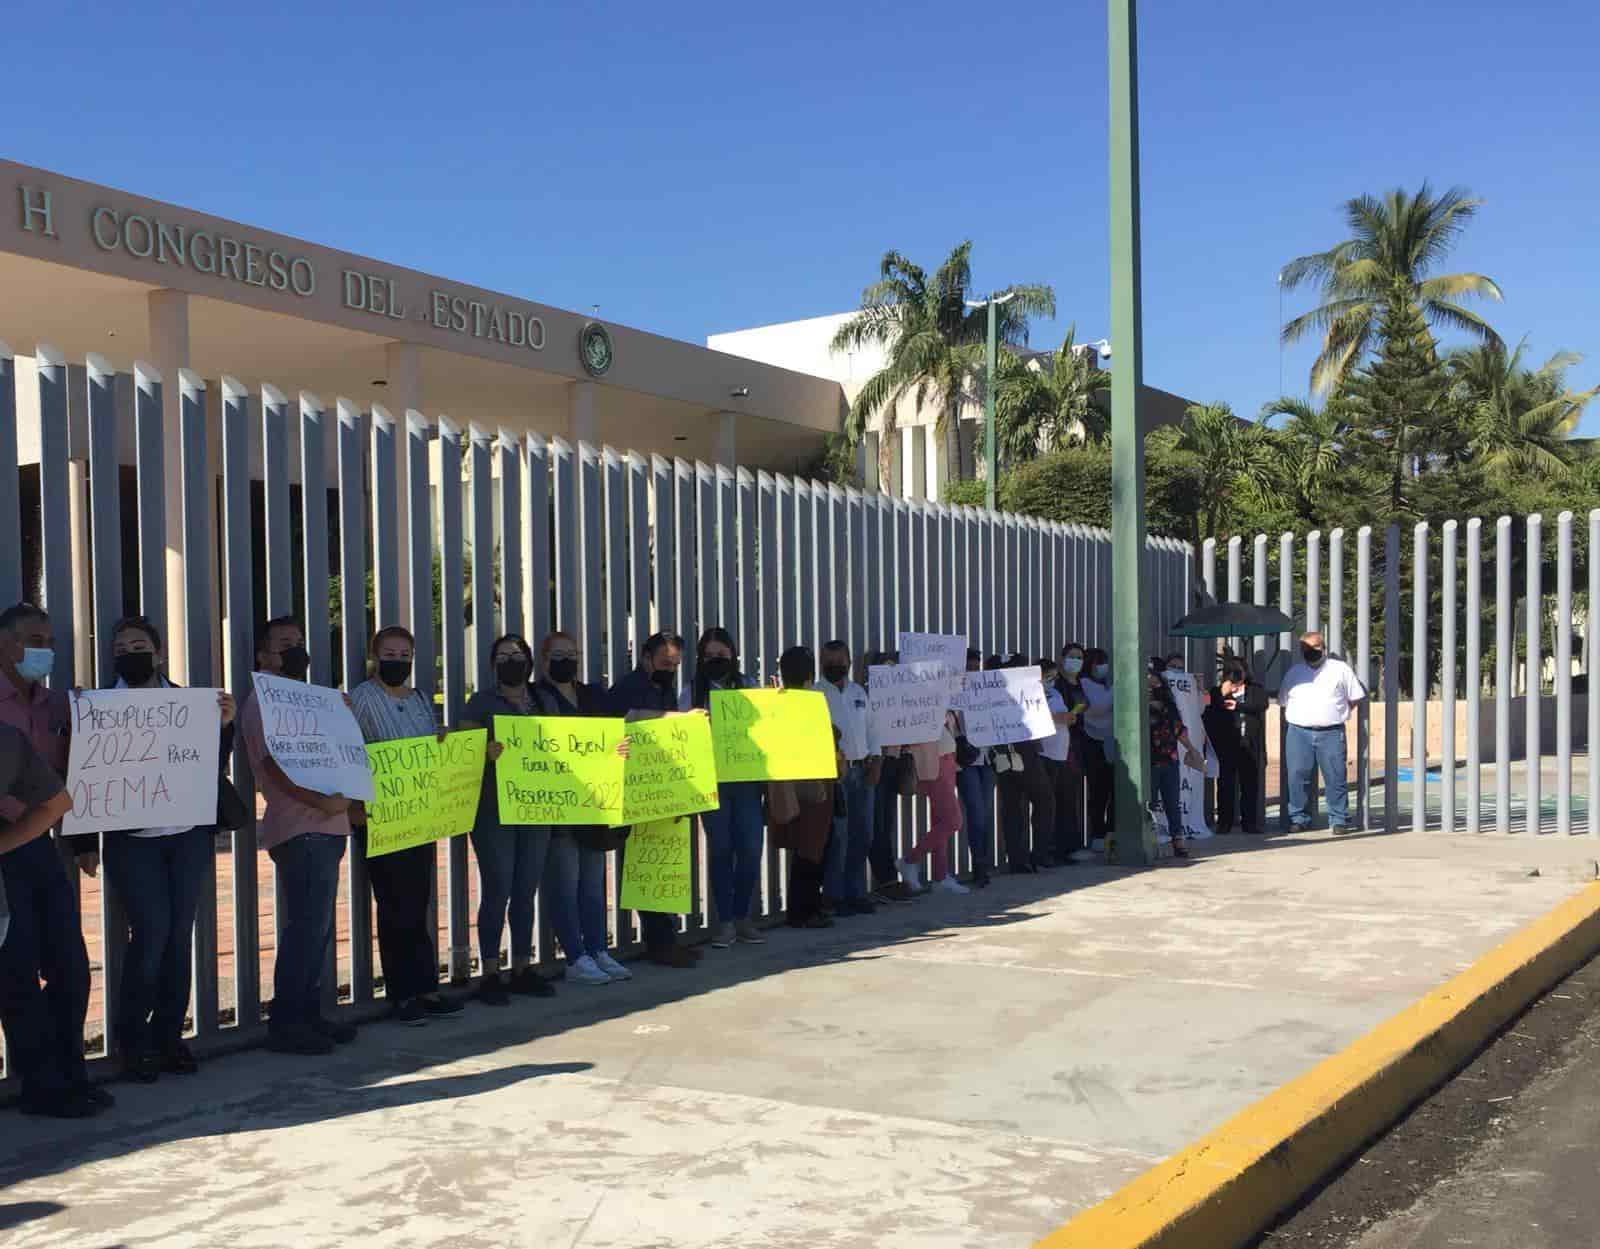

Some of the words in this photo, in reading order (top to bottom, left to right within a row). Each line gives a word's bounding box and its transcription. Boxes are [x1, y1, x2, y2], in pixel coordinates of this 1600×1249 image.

[19, 185, 55, 237] H
[92, 206, 316, 297] CONGRESO
[343, 270, 406, 320] DEL
[431, 290, 546, 351] ESTADO
[74, 697, 189, 733] PRESUPUESTO
[272, 704, 327, 737] 2022
[506, 722, 521, 749] NO
[534, 723, 561, 753] NOS
[568, 729, 606, 756] DEJEN
[671, 721, 689, 741] NO
[80, 730, 159, 770] 2022
[168, 744, 201, 763] PARA
[555, 760, 574, 775] DEL
[669, 764, 696, 781] 2022
[72, 773, 171, 819] OEEMA
[380, 777, 405, 799] NO
[412, 771, 440, 793] NOS
[582, 782, 620, 810] 2022
[637, 847, 684, 866] 2022
